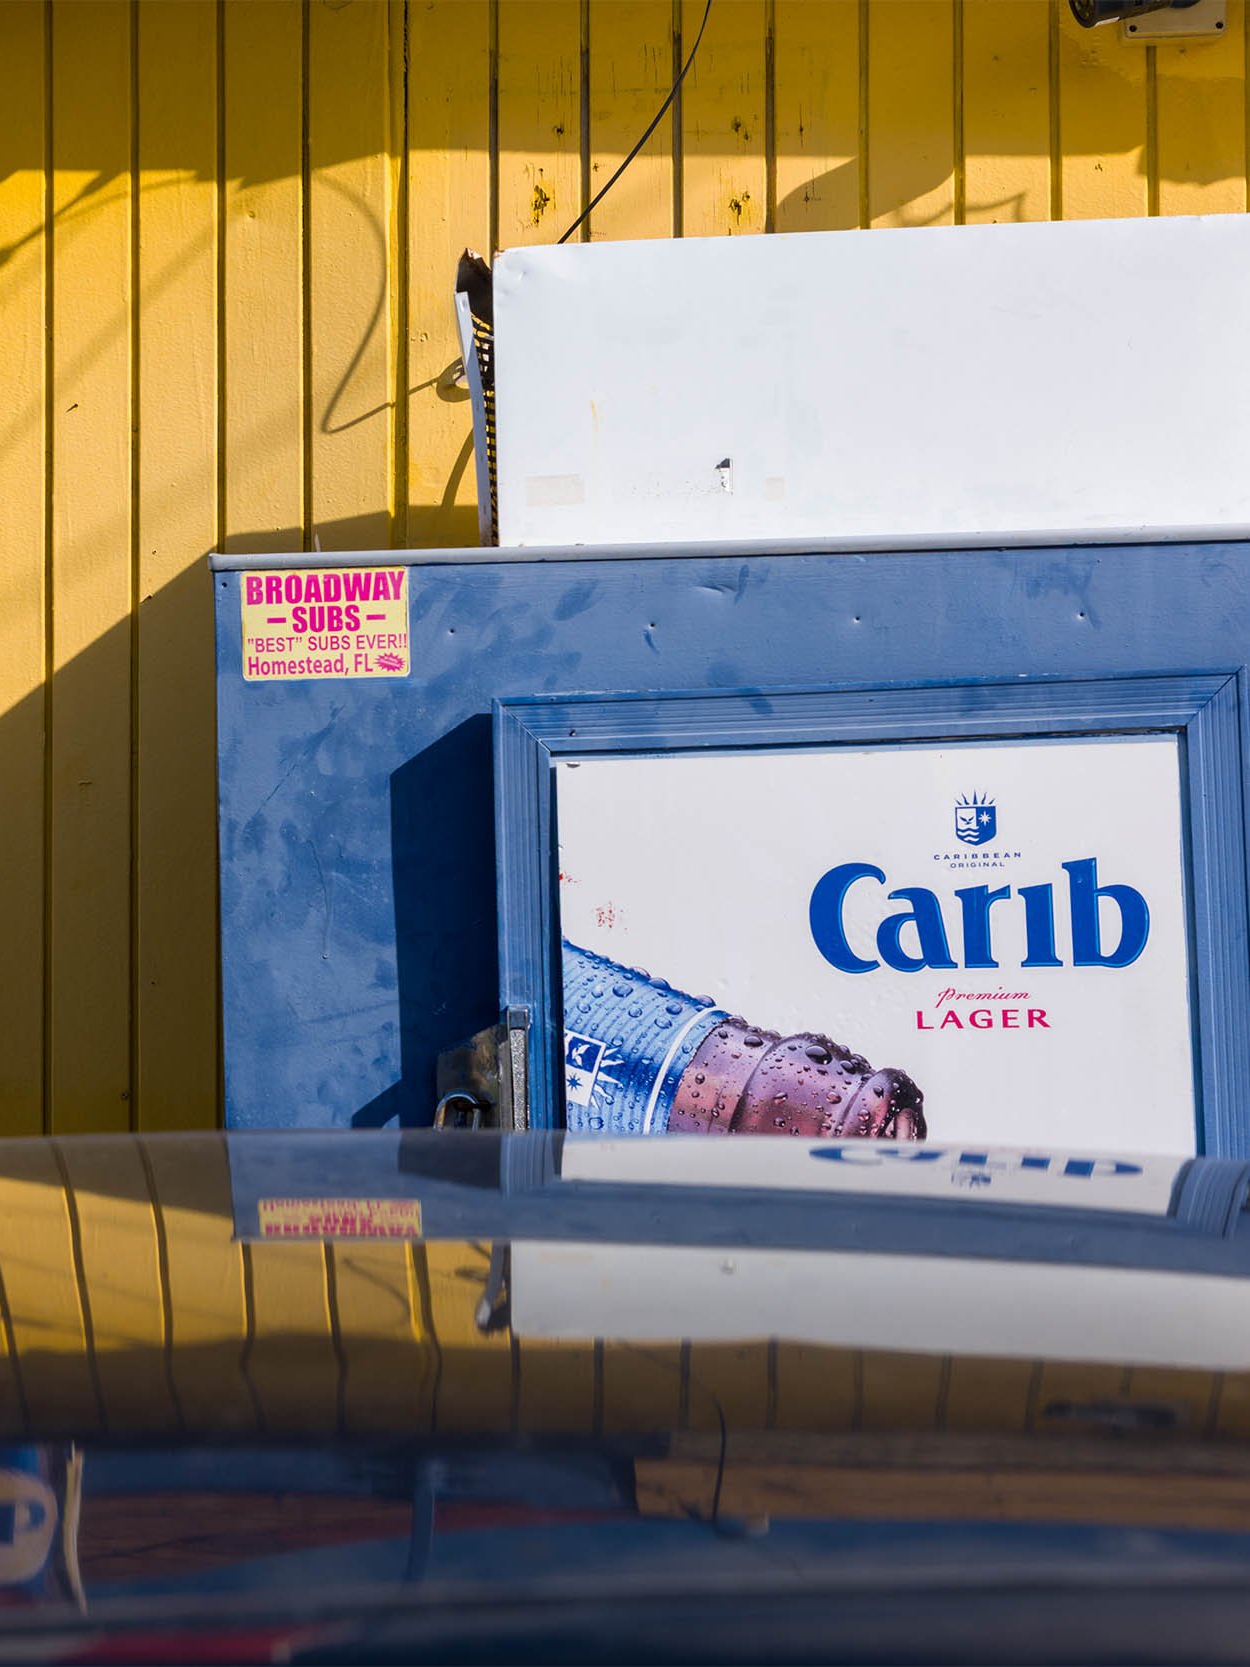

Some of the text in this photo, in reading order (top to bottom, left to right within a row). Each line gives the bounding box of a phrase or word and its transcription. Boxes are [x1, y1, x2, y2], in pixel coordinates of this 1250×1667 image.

[245, 570, 405, 606] BROADWAY
[247, 633, 407, 653] "BEST" SUBS EVER!!
[247, 653, 350, 676] Homestead,
[354, 653, 374, 673] FL
[933, 851, 1022, 861] CARIBBEAN
[949, 861, 1006, 869] ORIGINAL
[808, 856, 1151, 974] Carib
[915, 1008, 1052, 1030] LAGER
